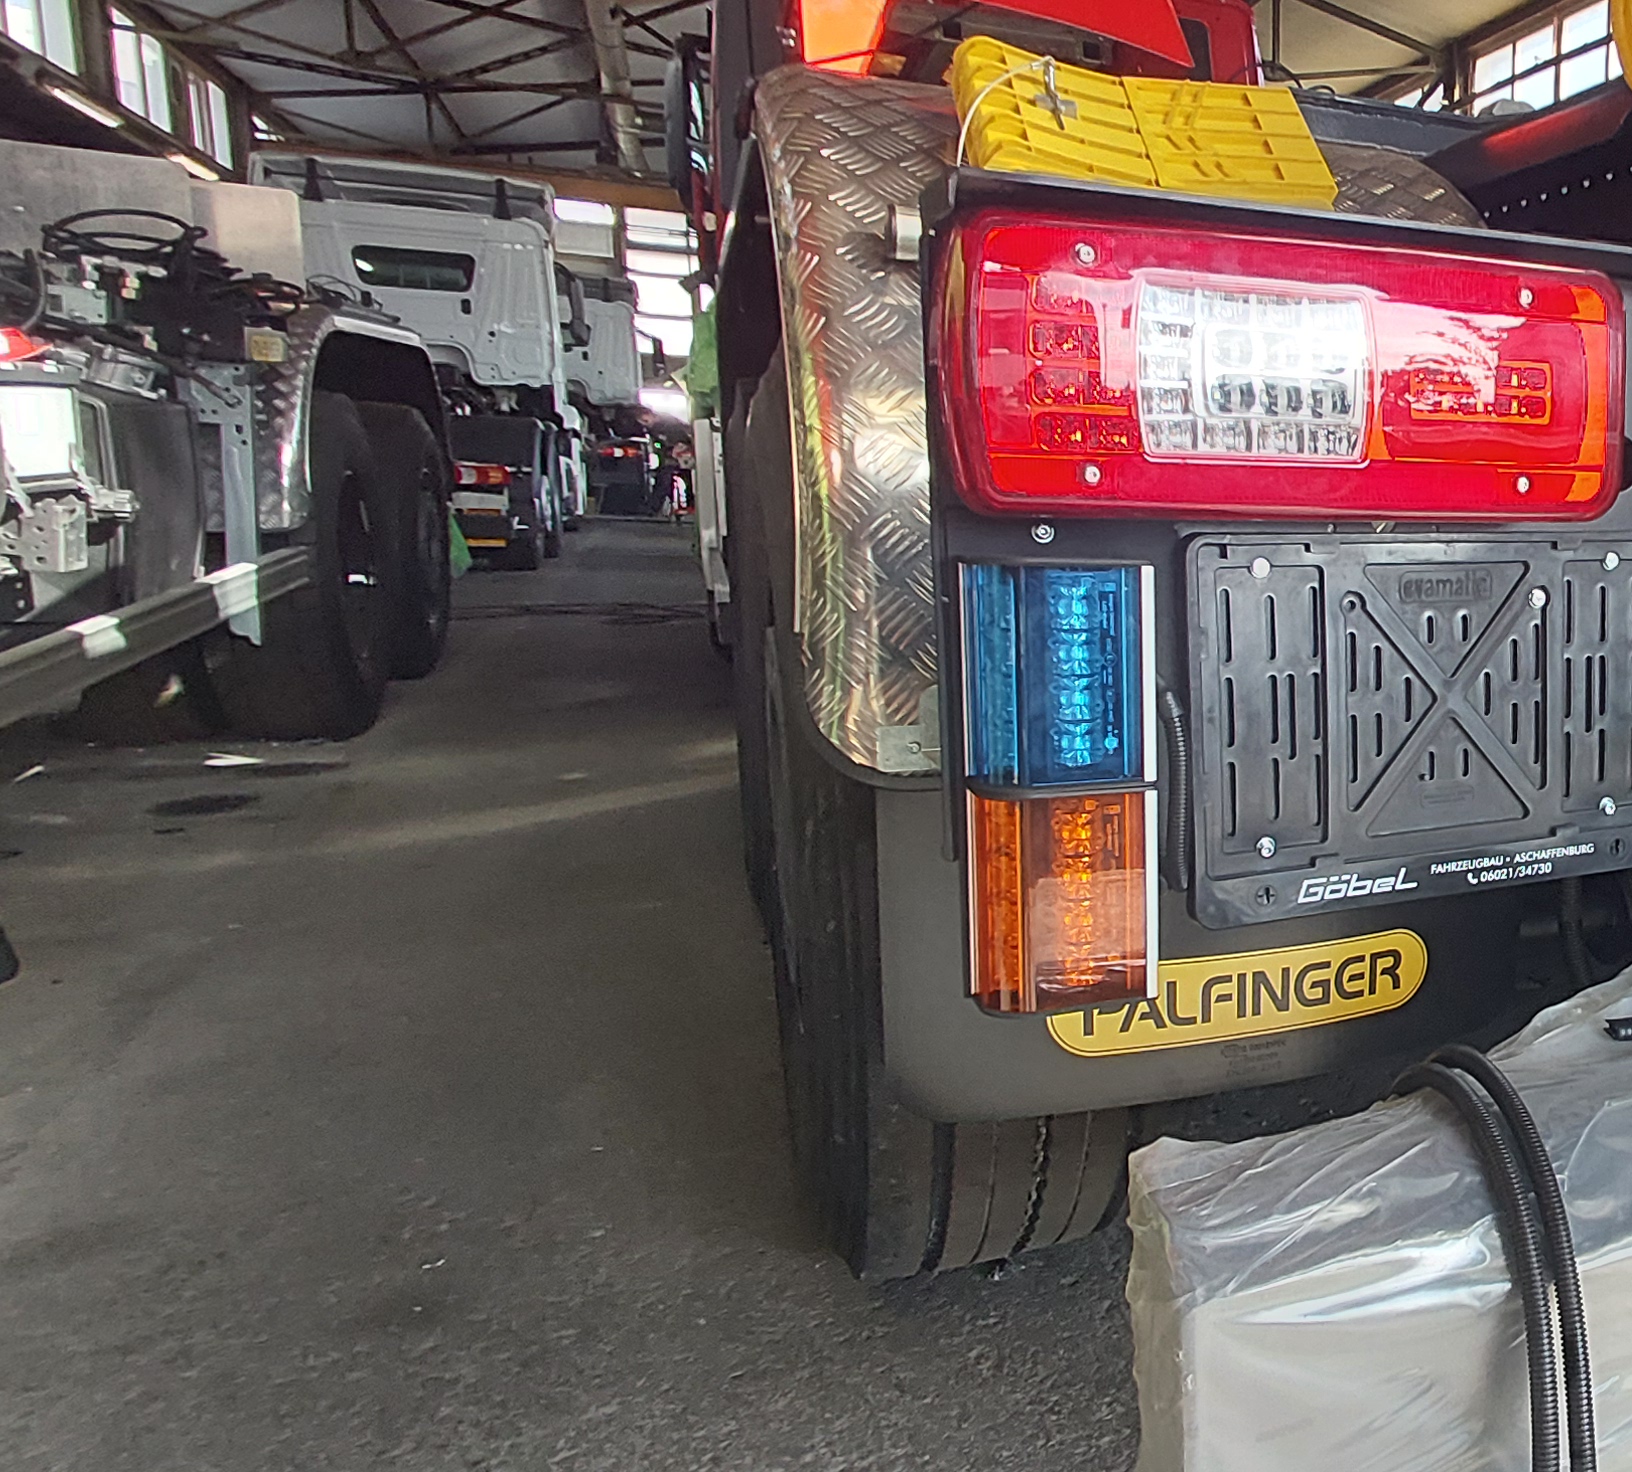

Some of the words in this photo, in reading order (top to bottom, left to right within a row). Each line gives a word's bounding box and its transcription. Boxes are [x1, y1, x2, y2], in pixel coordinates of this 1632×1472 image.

[1430, 855, 1504, 875] FAHRZEUGBAU
[1514, 843, 1595, 864] ASCHAFFENBURG
[1480, 862, 1553, 883] 06021/34730
